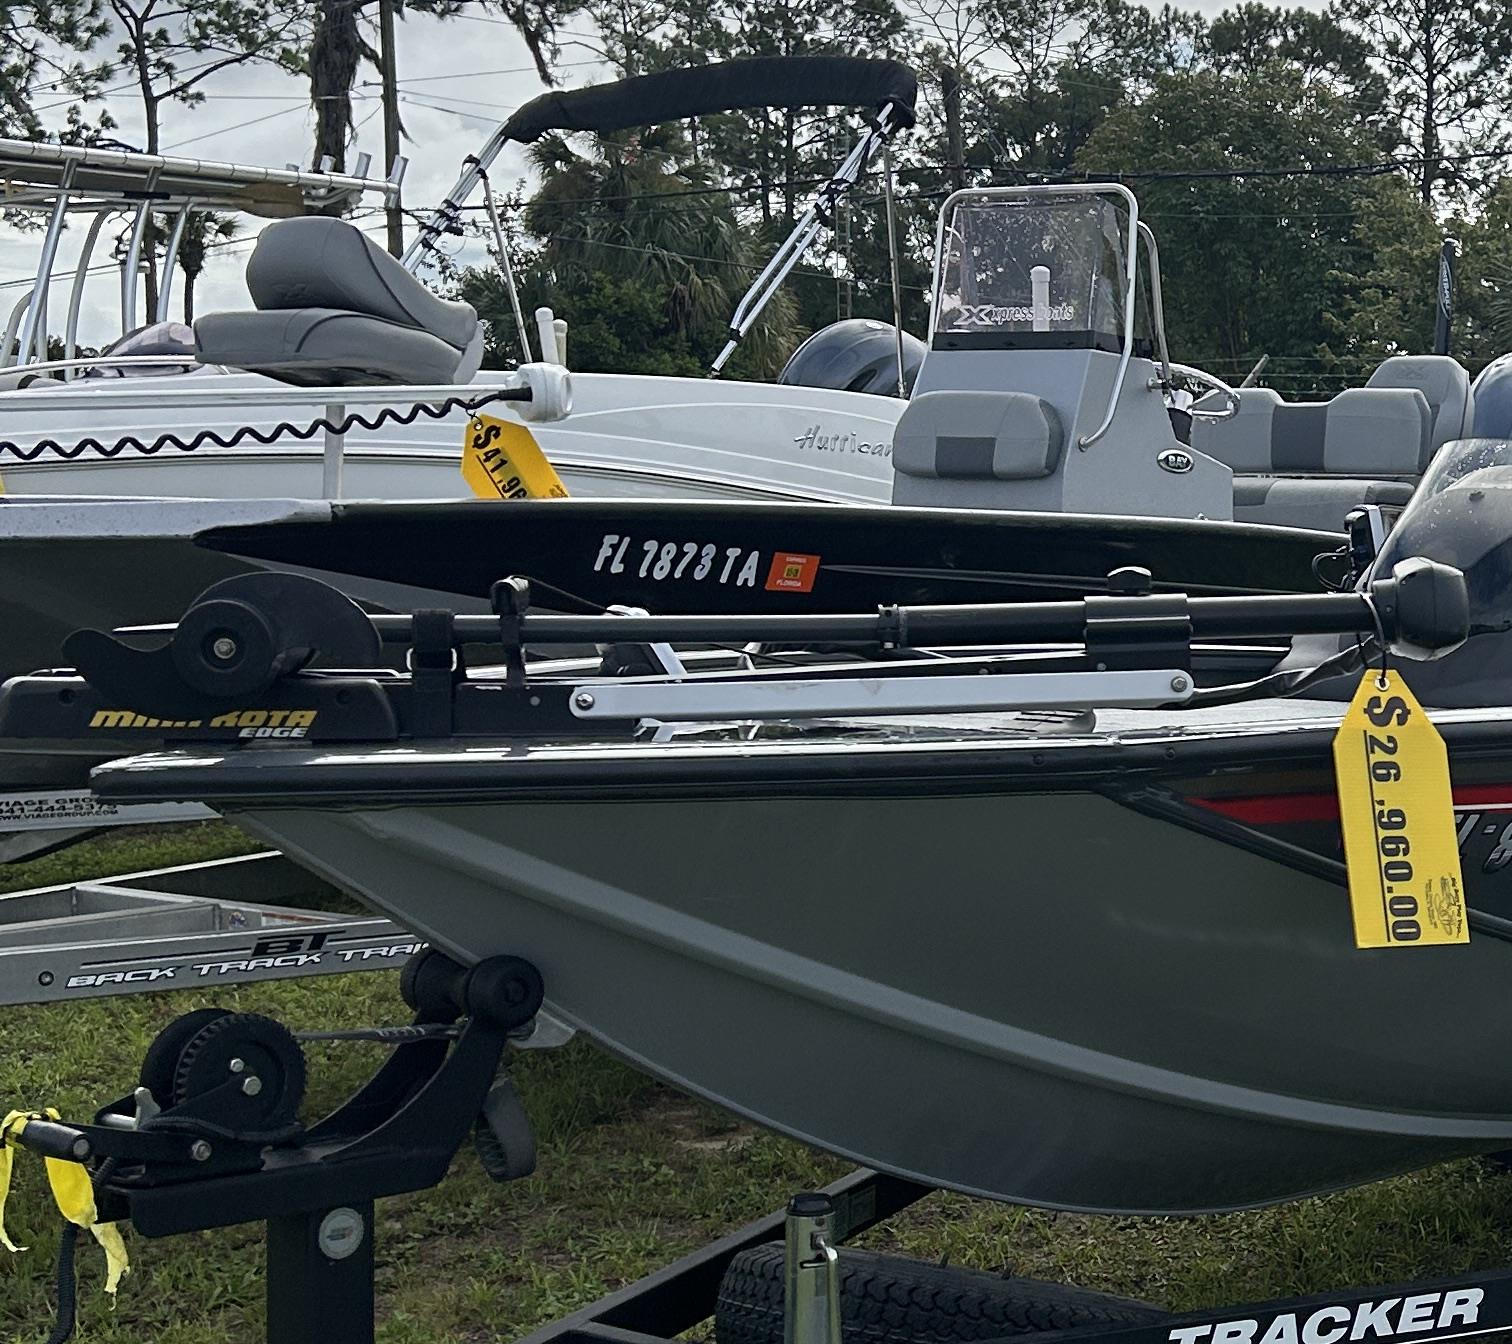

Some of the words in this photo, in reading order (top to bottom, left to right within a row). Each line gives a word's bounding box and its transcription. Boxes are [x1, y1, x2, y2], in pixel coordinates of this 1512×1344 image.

[594, 534, 631, 574] FL
[638, 539, 717, 581] 7873
[719, 547, 760, 588] TA
[238, 727, 308, 738] EDGE
[66, 966, 178, 989] BACK
[193, 952, 322, 975] TRACK
[338, 942, 429, 961] TRAI
